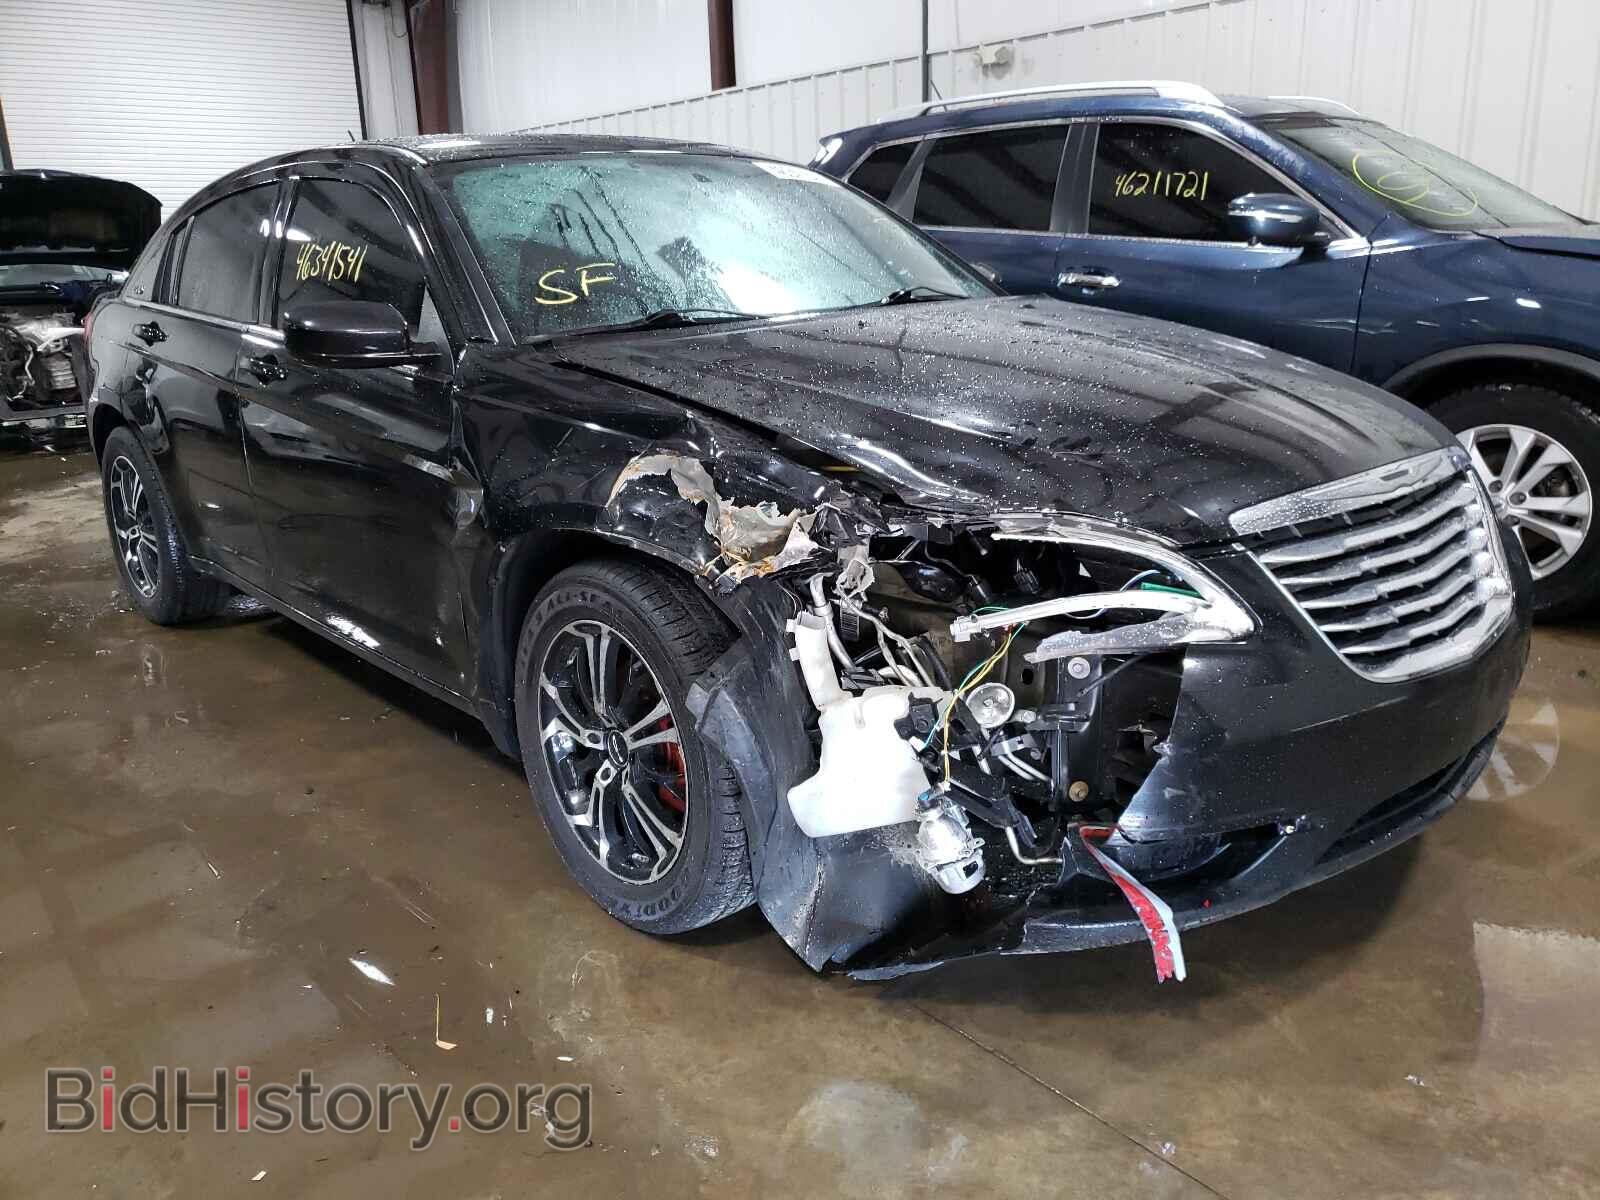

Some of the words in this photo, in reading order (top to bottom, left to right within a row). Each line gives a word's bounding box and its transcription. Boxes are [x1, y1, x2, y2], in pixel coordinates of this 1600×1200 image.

[1115, 170, 1208, 200] 46211721
[296, 241, 368, 282] 46341541
[534, 263, 616, 304] SF
